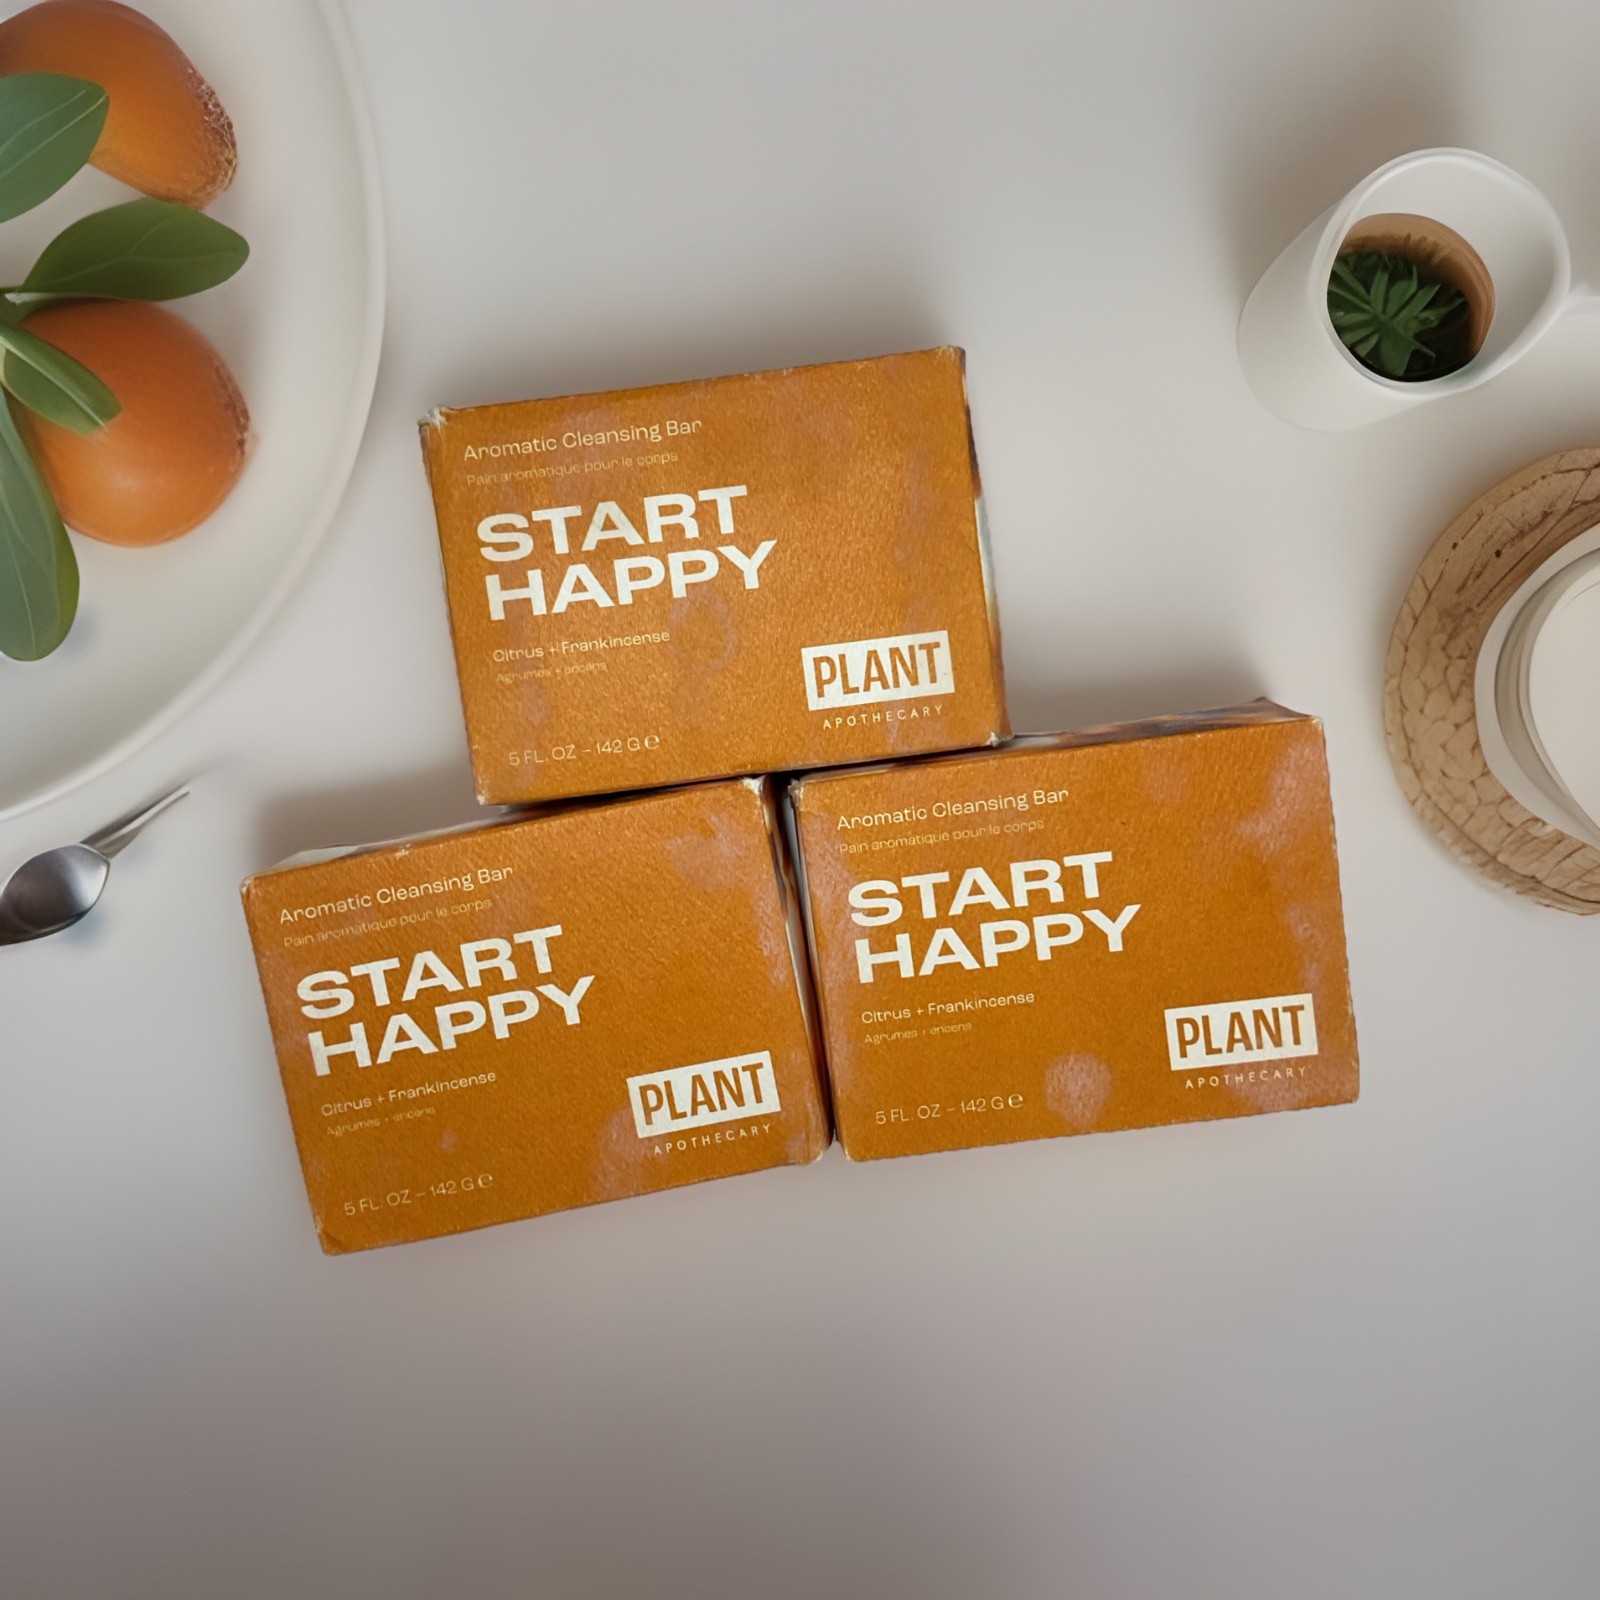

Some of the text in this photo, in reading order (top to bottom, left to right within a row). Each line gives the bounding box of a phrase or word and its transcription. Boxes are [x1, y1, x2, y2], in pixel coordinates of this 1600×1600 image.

[464, 419, 702, 461] Aromatic Cleansing Bar
[466, 451, 678, 487] Pain aromatique pour le corps
[477, 485, 747, 562] START
[485, 539, 777, 620] HAPPY
[493, 632, 670, 662] Citrus + Frankincense
[496, 669, 551, 684] Agrumes
[813, 641, 941, 698] PLANT
[823, 705, 942, 730] APOTHECARY
[509, 752, 520, 766] 5
[523, 750, 549, 764] FL.
[552, 744, 577, 760] OZ
[596, 739, 623, 755] 142
[627, 738, 640, 751] G
[837, 789, 1069, 831] Aromatic Cleansing Bar
[839, 819, 1044, 854] Pain aromatique pour le corps
[279, 867, 513, 925] Aromatic Cleansing Bar
[848, 851, 1113, 927] START
[283, 898, 492, 949] Pain aromatique pour le corps
[855, 904, 1142, 984] HAPPY
[296, 924, 563, 1019] START
[308, 975, 595, 1077] HAPPY
[861, 993, 1035, 1024] Citrus + Frankincense
[864, 1029, 918, 1045] Agrumes
[1176, 1004, 1305, 1059] PLANT
[321, 1072, 497, 1117] Citrus + Frankincense
[639, 1062, 764, 1126] PLANT
[1185, 1067, 1305, 1090] APOTHECARY
[326, 1118, 380, 1137] Agrumes
[875, 1111, 887, 1125] 5
[917, 1104, 941, 1119] OZ
[960, 1098, 987, 1114] 142
[991, 1096, 1004, 1110] G
[654, 1123, 771, 1156] APOTHECARY
[344, 1201, 356, 1216] 5
[386, 1189, 412, 1207] OZ
[430, 1180, 458, 1197] 142
[460, 1177, 475, 1191] G
